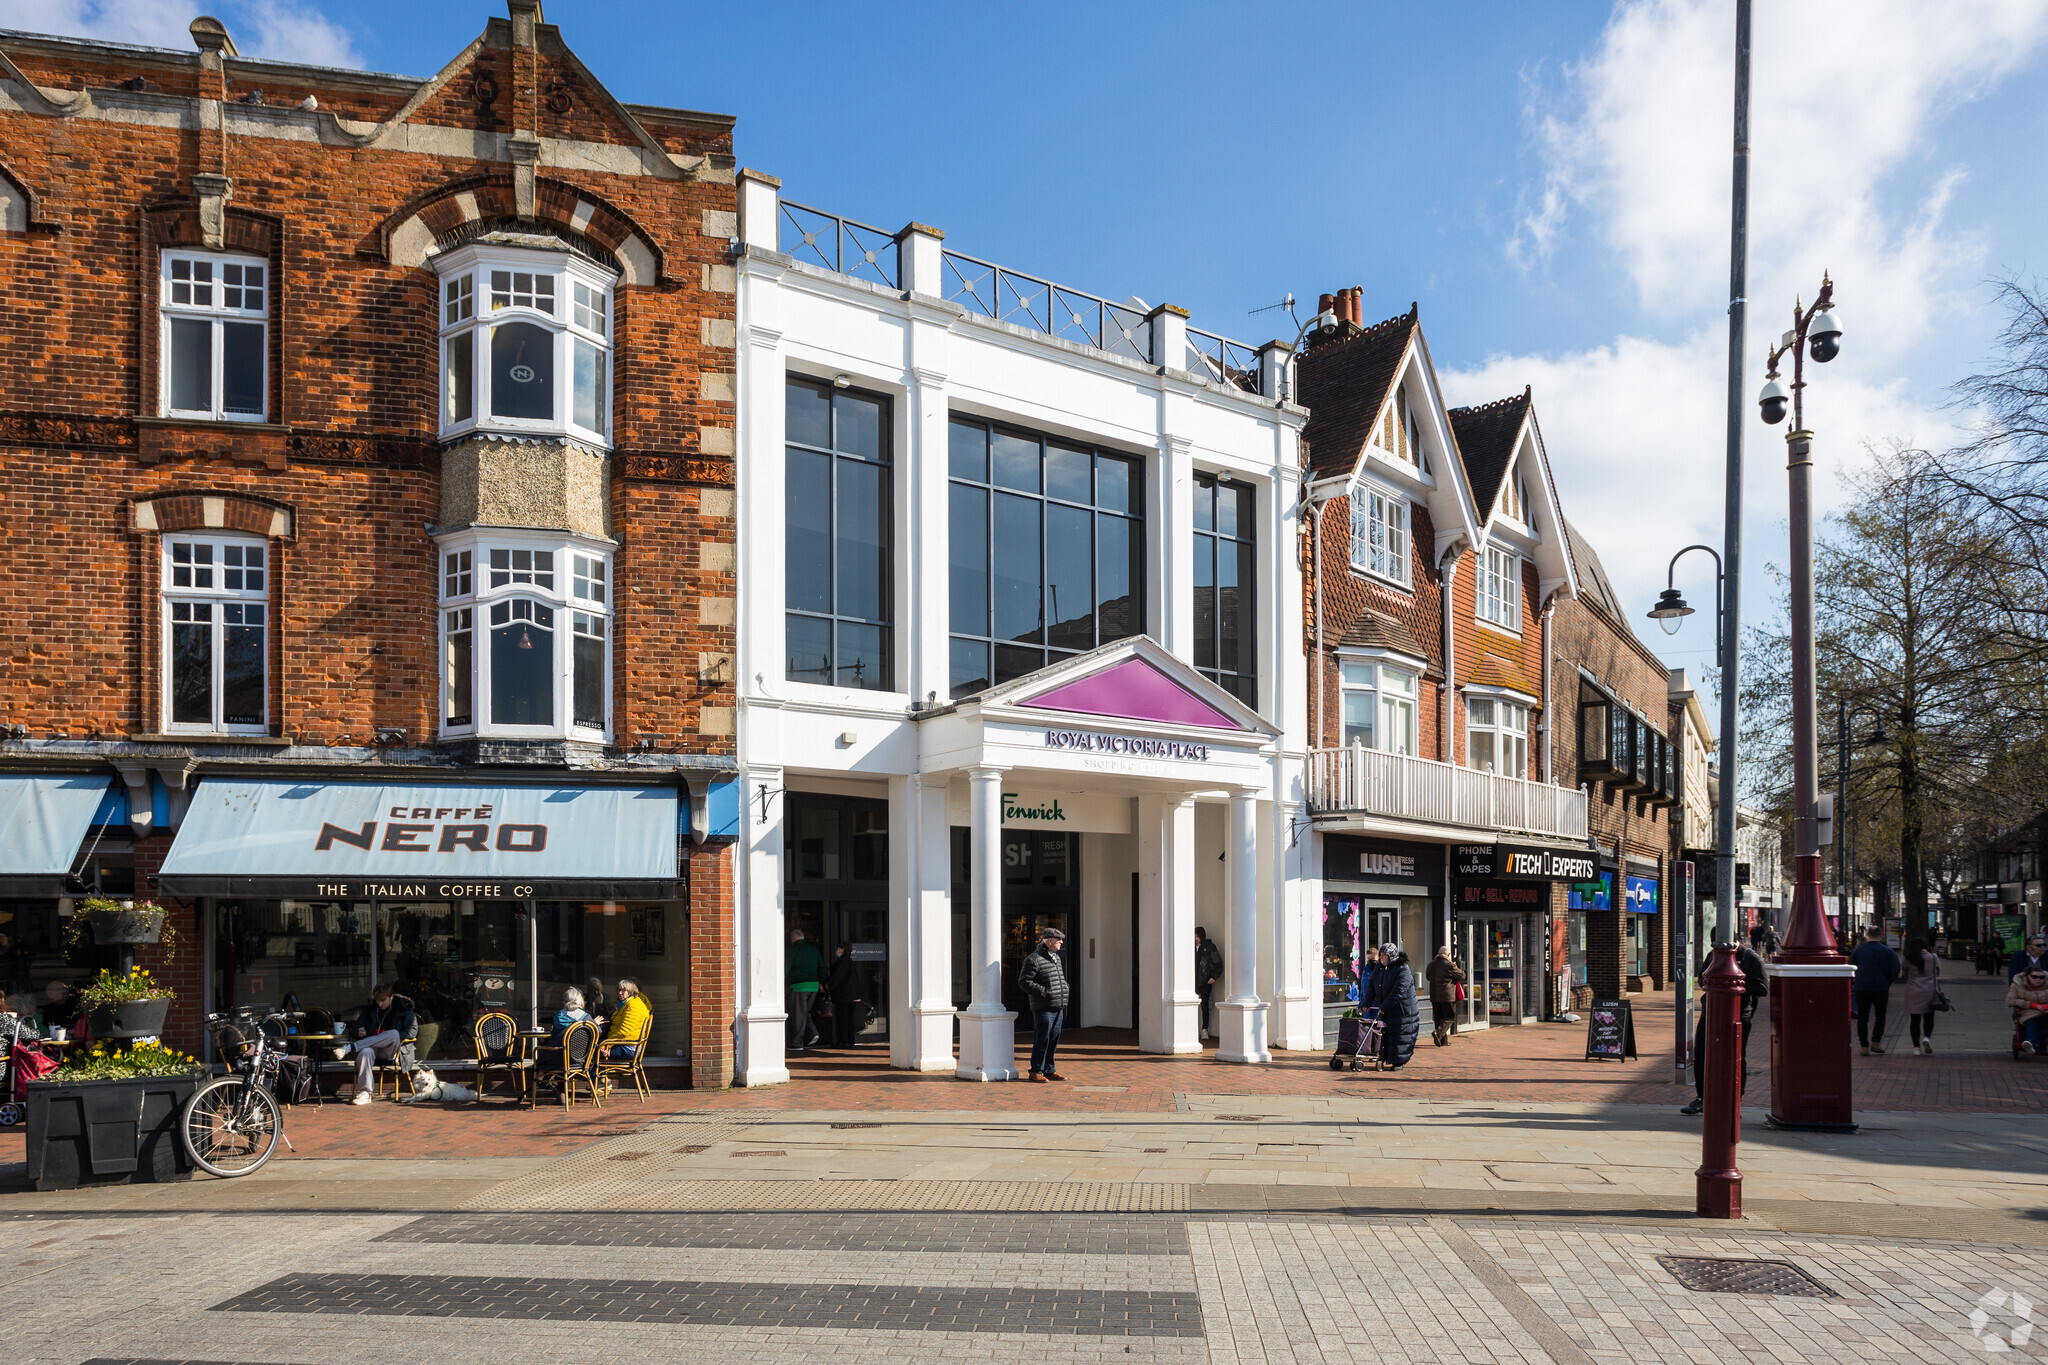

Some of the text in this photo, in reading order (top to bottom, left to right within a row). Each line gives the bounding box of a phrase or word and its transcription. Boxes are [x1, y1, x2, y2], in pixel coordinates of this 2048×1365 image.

[576, 720, 602, 729] ESPRESSO
[1047, 730, 1211, 761] ROYAL VICTORIA PLACE
[1084, 758, 1135, 773] SHOPPING
[389, 804, 494, 820] CAFFÈ
[1000, 792, 1066, 824] Fenwick
[314, 821, 548, 853] NERO
[1459, 846, 1492, 855] PHONE
[1360, 853, 1402, 875] LUSH
[1471, 856, 1479, 864] &
[1514, 853, 1594, 878] TECH EXPERTS
[1459, 864, 1491, 873] VAPES
[317, 884, 348, 896] THE
[364, 884, 426, 896] ITALIAN
[439, 884, 501, 897] COFFEE
[1464, 887, 1481, 902] BUY
[1486, 887, 1505, 903] SELL
[1509, 888, 1538, 904] REPAIRS
